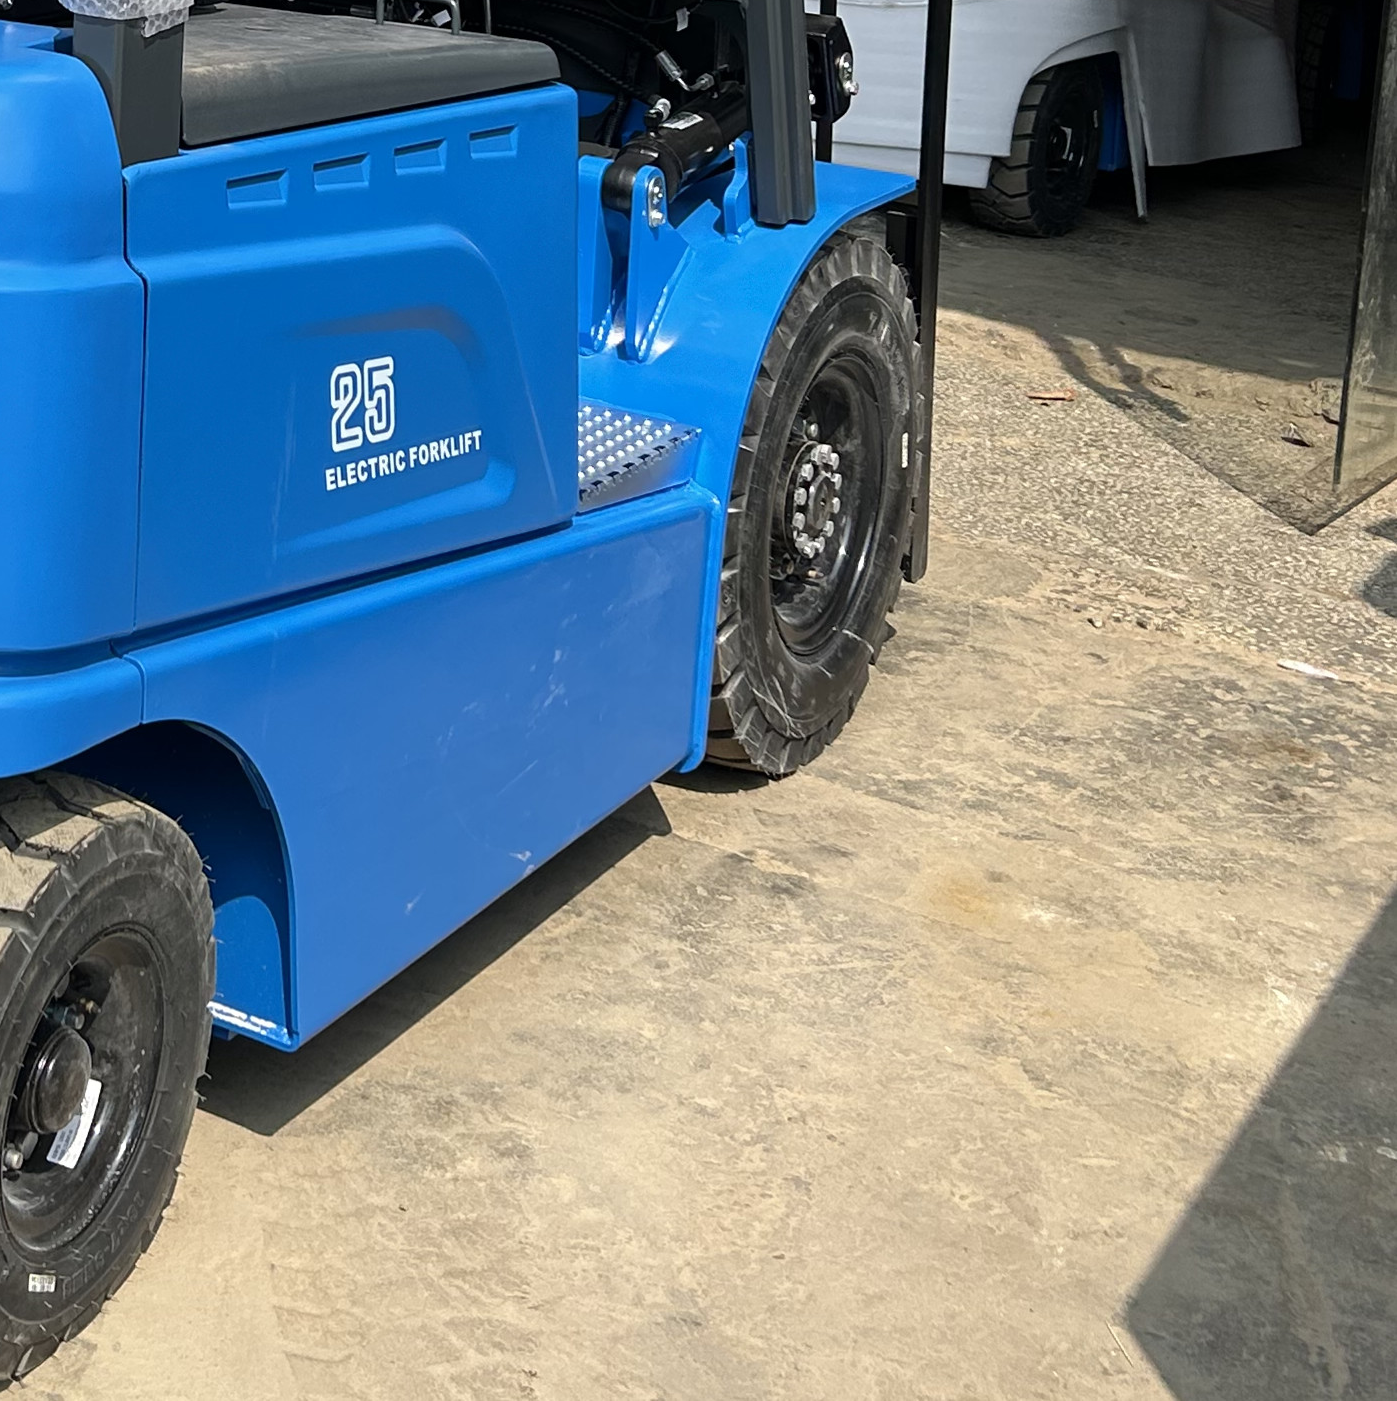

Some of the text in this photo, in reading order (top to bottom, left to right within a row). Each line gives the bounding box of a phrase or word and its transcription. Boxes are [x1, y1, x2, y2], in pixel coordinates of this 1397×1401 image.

[330, 356, 395, 452] 25
[325, 430, 482, 491] ELECTRIC FORKLIFT
